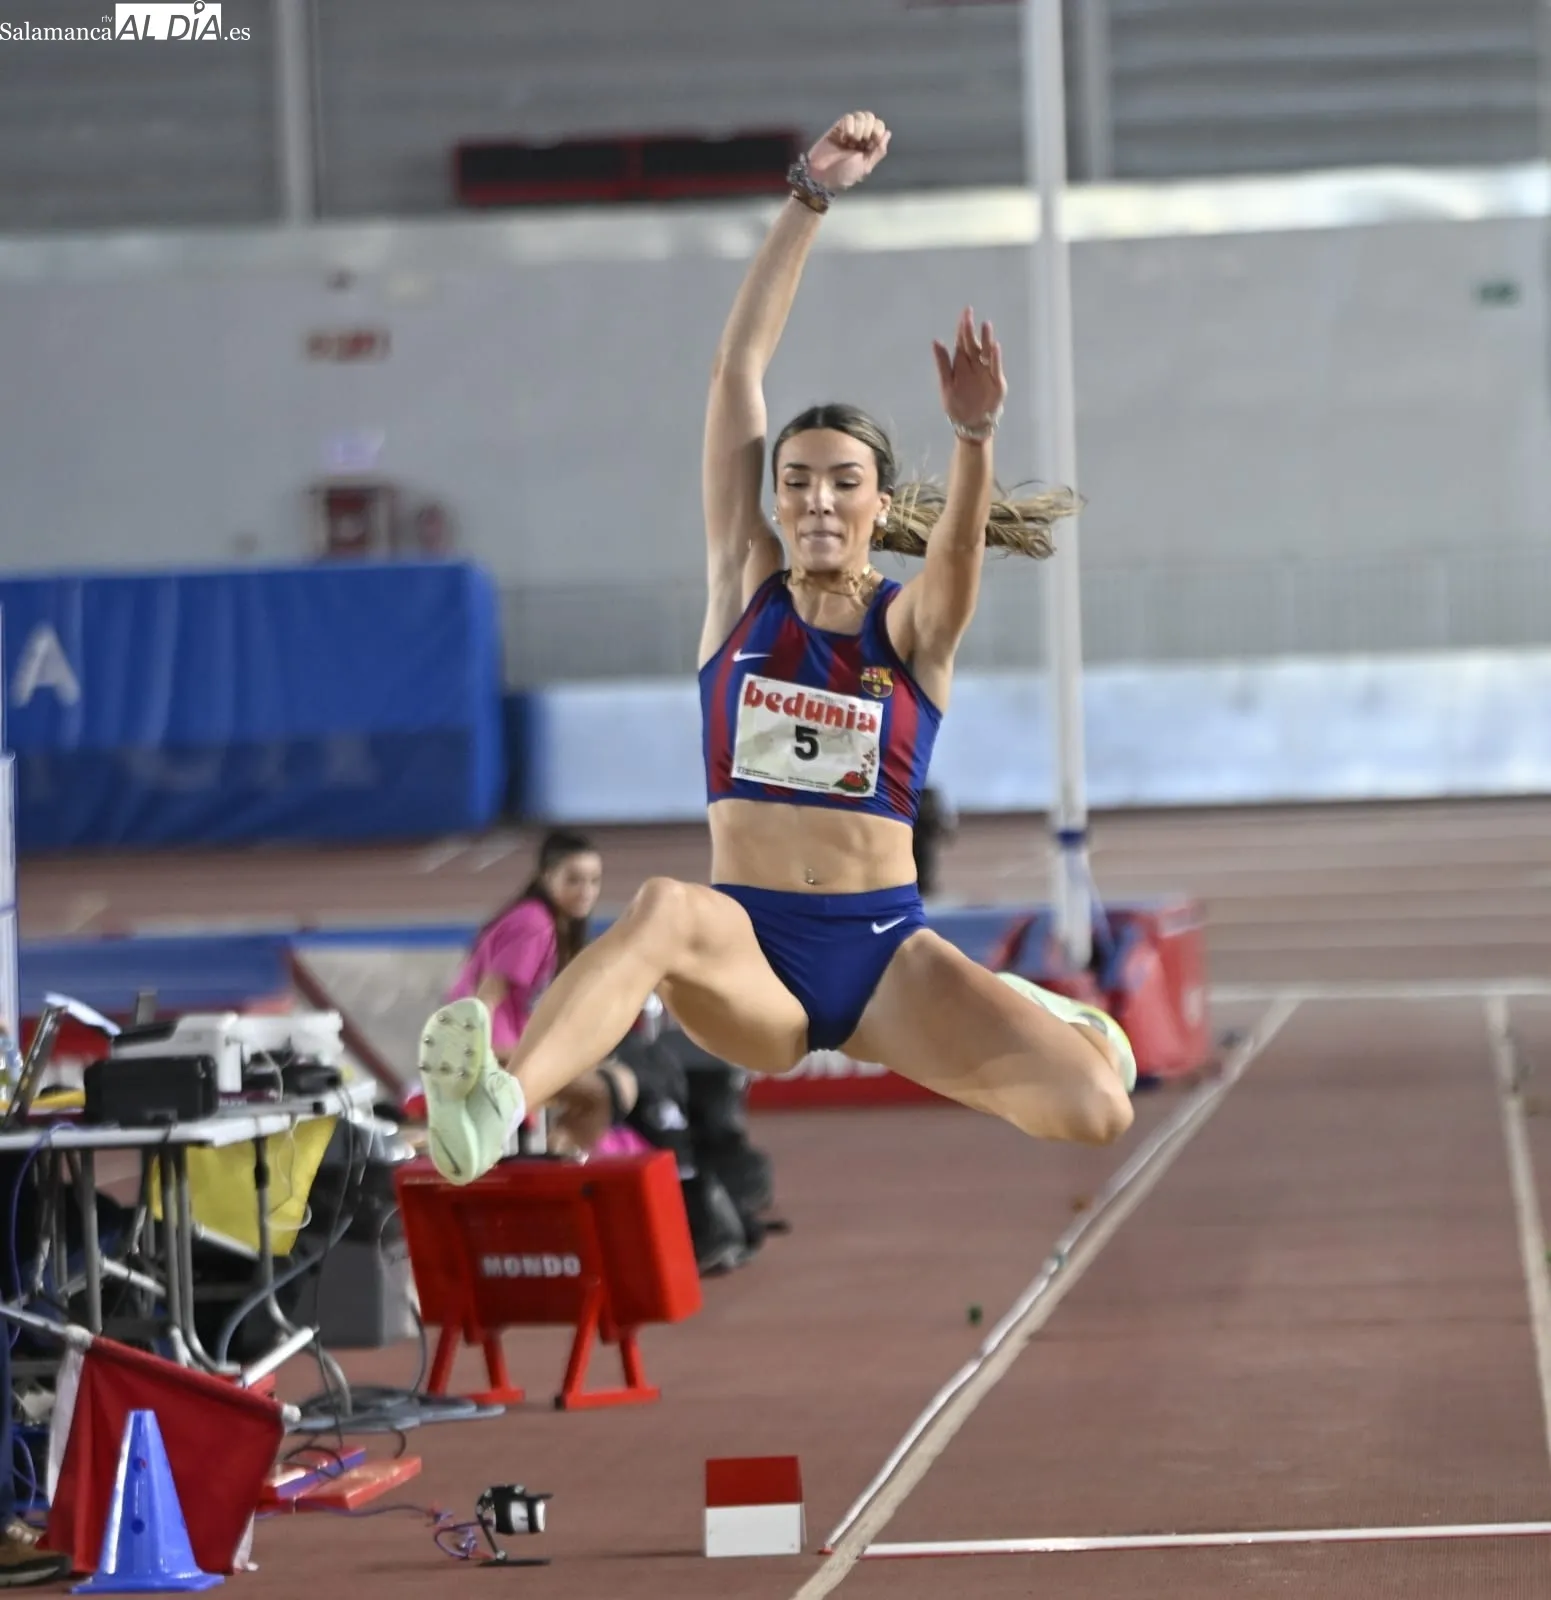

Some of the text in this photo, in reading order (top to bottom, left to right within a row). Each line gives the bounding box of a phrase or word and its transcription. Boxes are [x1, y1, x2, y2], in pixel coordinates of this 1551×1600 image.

[743, 681, 878, 734] bedunia
[793, 724, 820, 761] 5
[483, 1254, 581, 1278] MONDO
